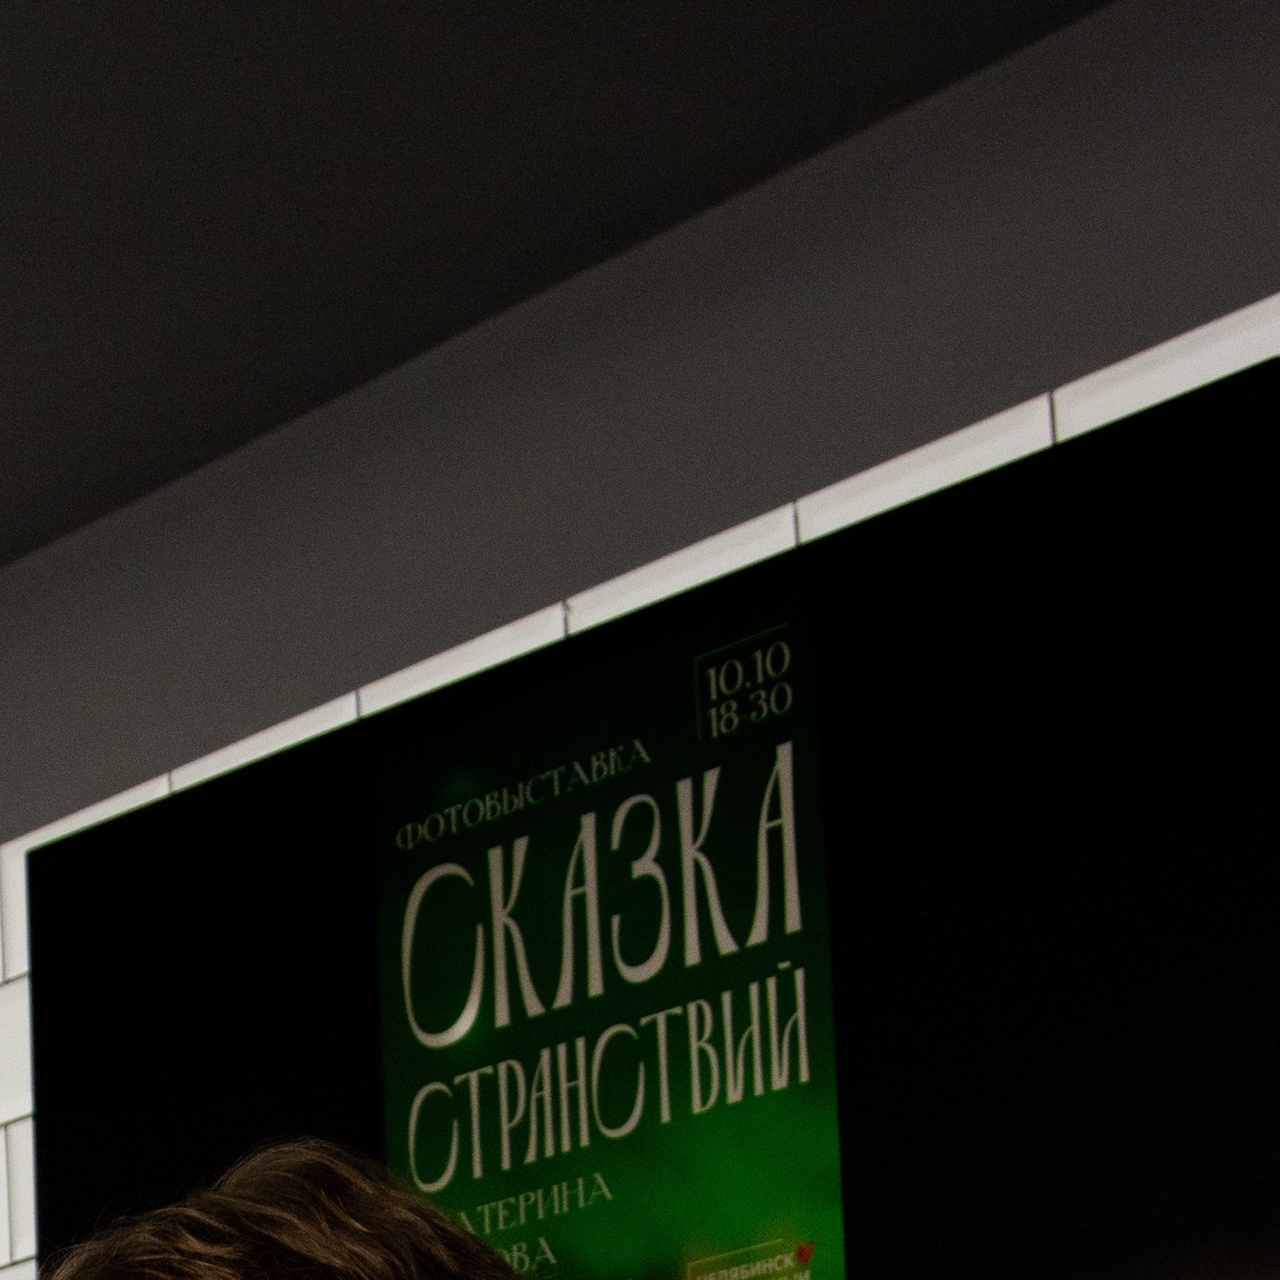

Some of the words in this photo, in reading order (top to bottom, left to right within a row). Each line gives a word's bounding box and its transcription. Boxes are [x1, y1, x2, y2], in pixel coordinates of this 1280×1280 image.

[705, 640, 792, 701] 10.10
[395, 738, 652, 850] ФОТОВЫСТАВКА
[401, 740, 802, 1048] СКАЗКА
[407, 960, 811, 1193] СТРАНСТВИЙ
[458, 1171, 613, 1235] АТЕРИНА
